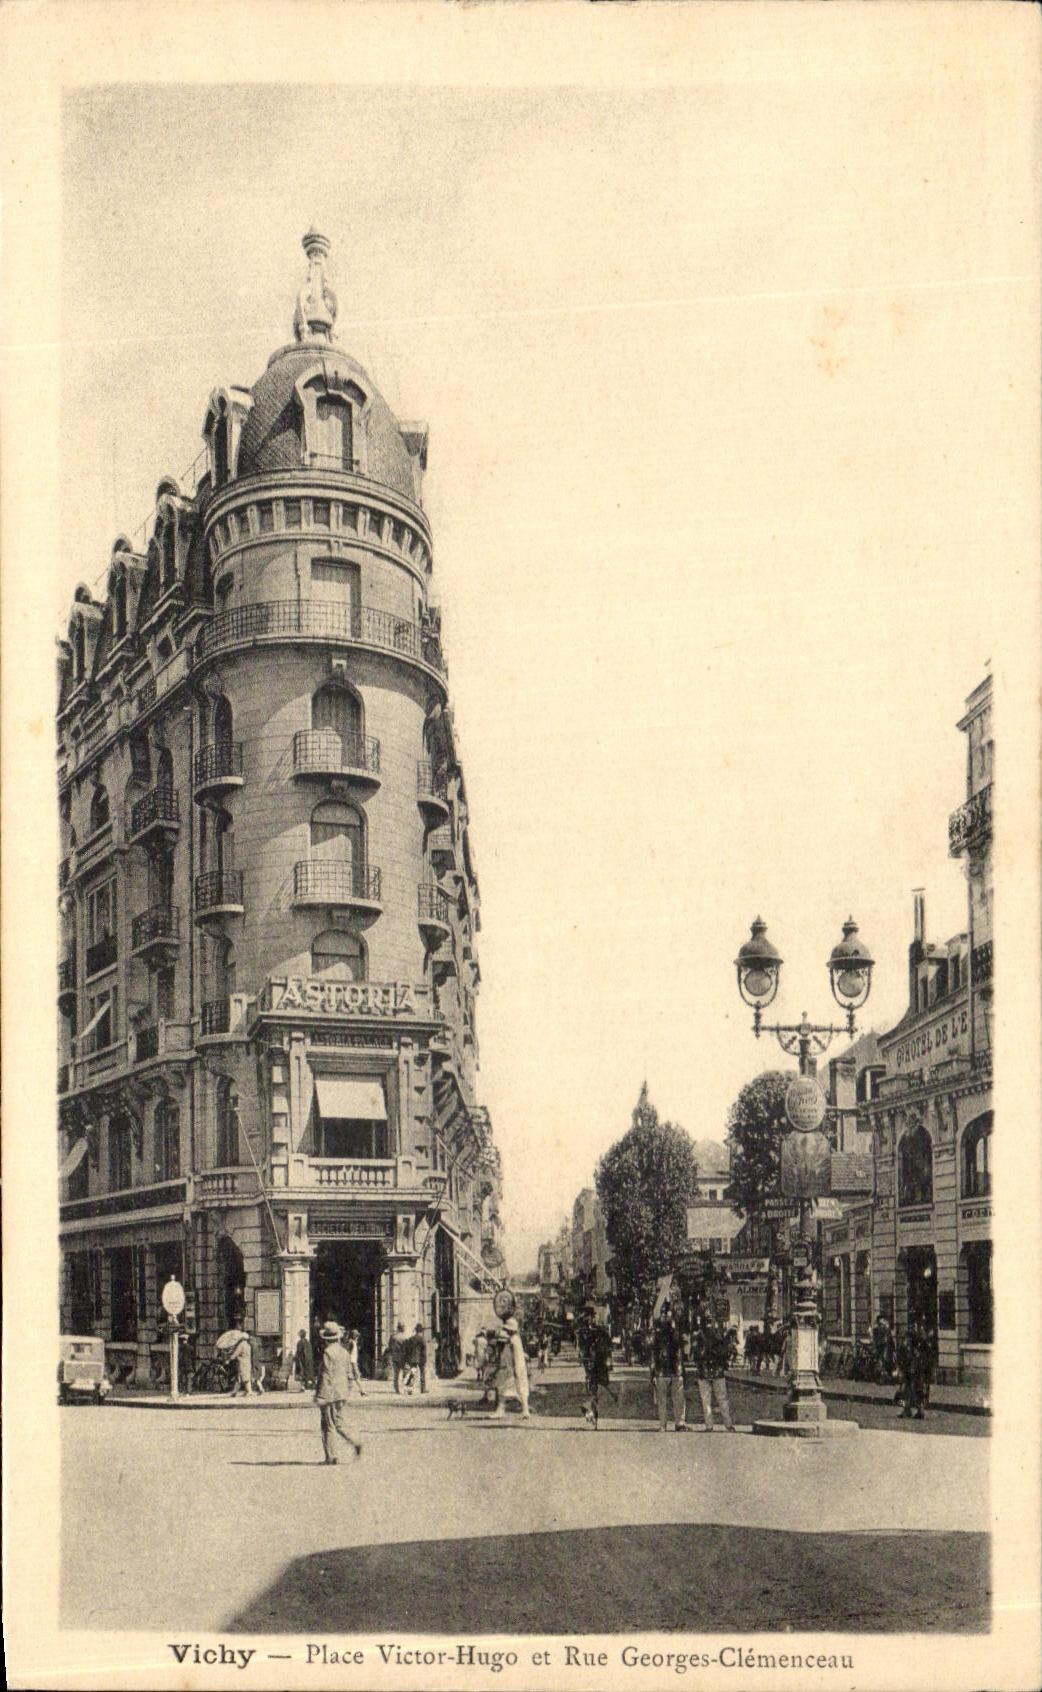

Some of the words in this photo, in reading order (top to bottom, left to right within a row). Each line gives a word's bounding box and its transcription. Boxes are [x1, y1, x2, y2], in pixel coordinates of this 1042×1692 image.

[278, 977, 417, 1011] ASTORIA
[905, 1031, 933, 1063] HOTEL
[935, 1023, 948, 1049] DE
